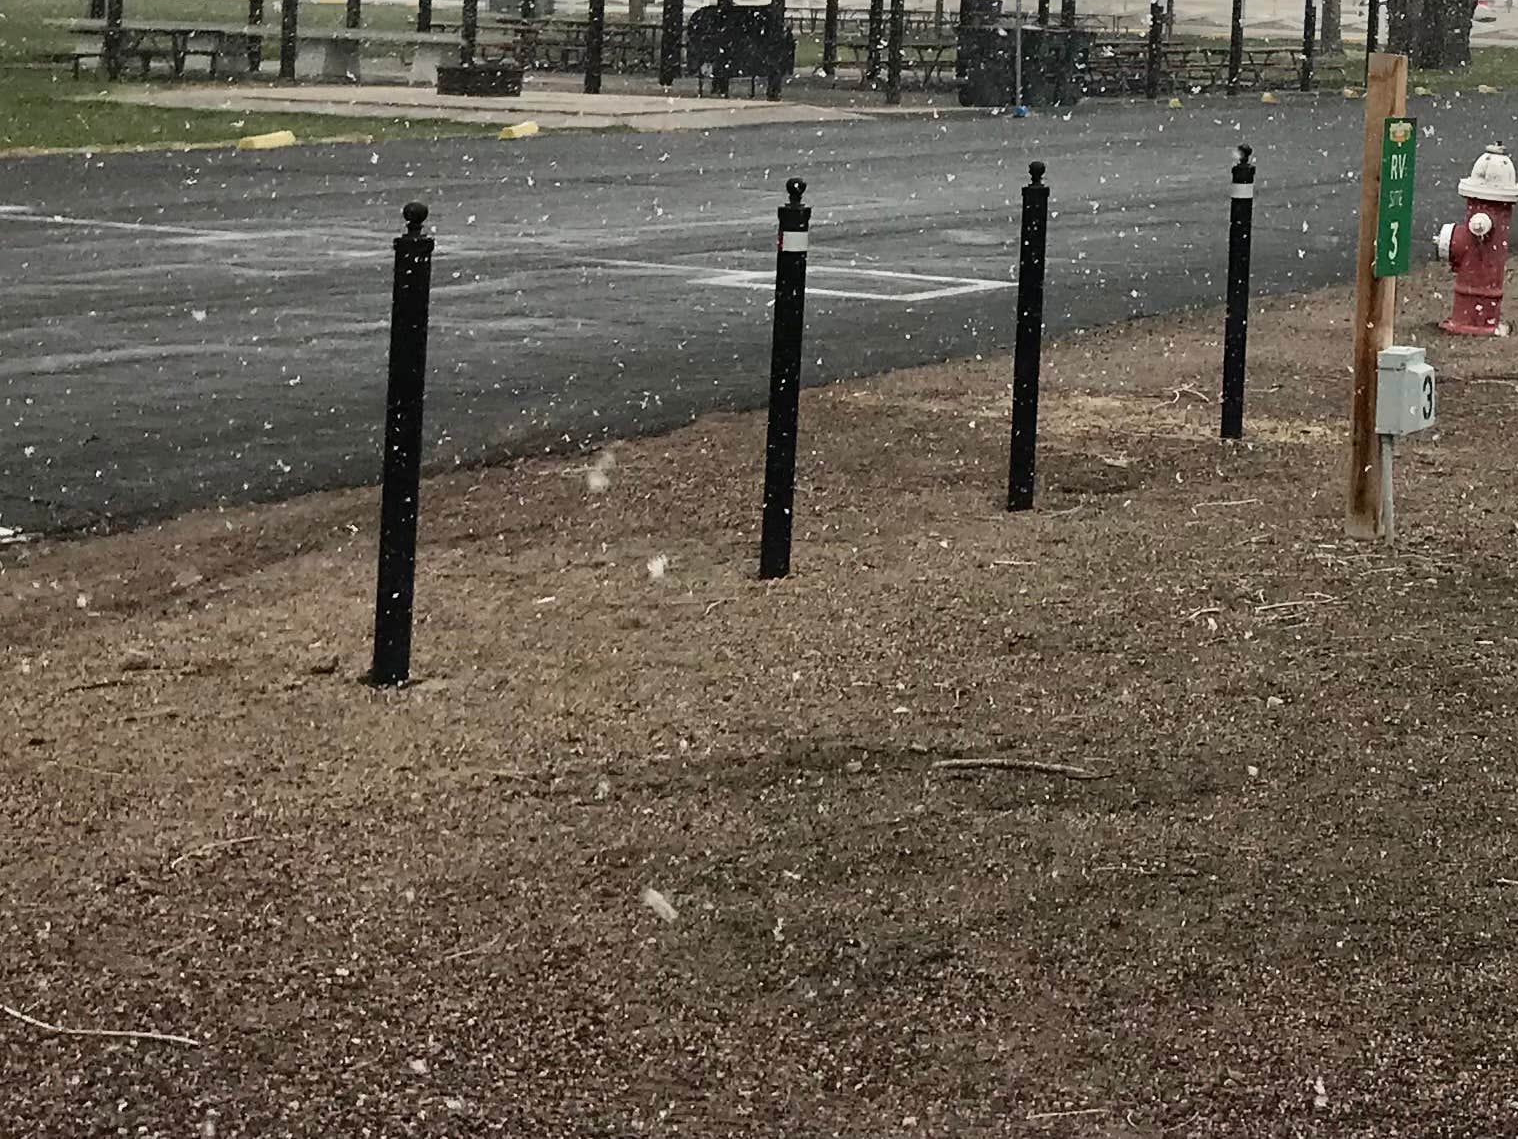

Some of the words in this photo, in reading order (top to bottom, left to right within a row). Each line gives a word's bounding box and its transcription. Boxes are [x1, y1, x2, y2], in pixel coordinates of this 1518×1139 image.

[1390, 153, 1407, 180] RV
[1389, 189, 1404, 209] SITE
[1388, 220, 1400, 260] 3
[1422, 375, 1433, 420] 3
